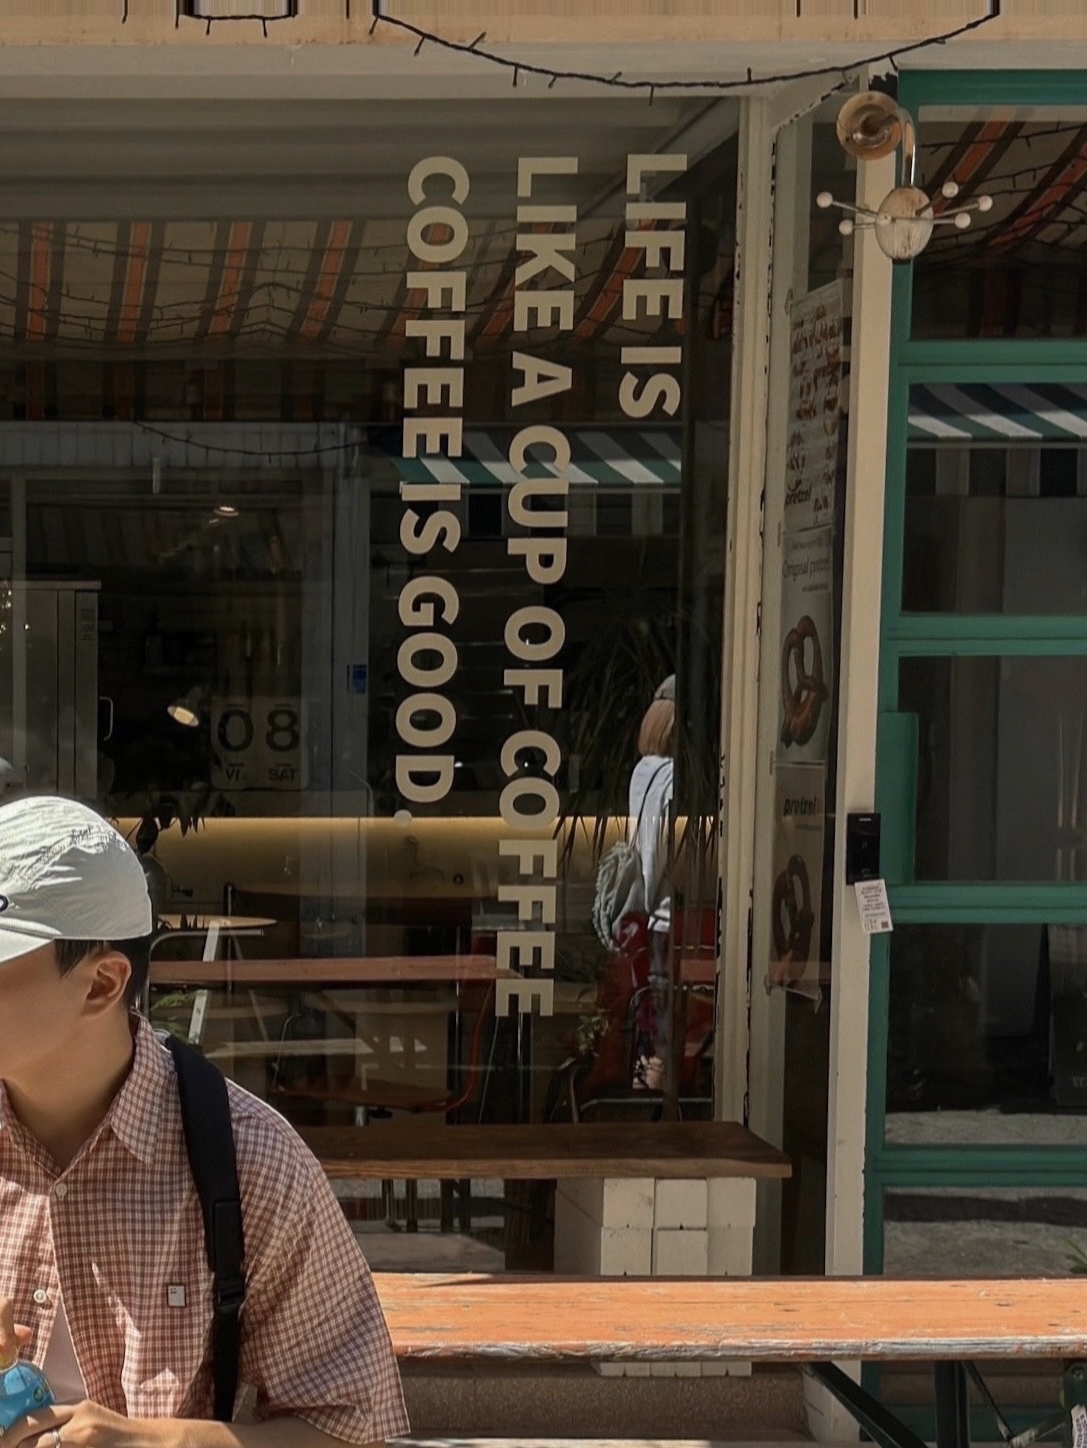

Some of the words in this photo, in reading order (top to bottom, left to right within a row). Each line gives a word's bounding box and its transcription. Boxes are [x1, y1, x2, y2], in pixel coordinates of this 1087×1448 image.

[402, 156, 470, 458] COFFEE
[513, 157, 579, 332] LIKE
[622, 154, 688, 321] LIFE
[511, 350, 573, 407] A
[618, 346, 682, 419] IS
[399, 483, 462, 555] IS
[507, 424, 572, 585] CUP
[217, 708, 300, 752] 08
[393, 575, 460, 829] GOOD.
[503, 605, 566, 709] OF
[495, 730, 562, 1017] COFFEE
